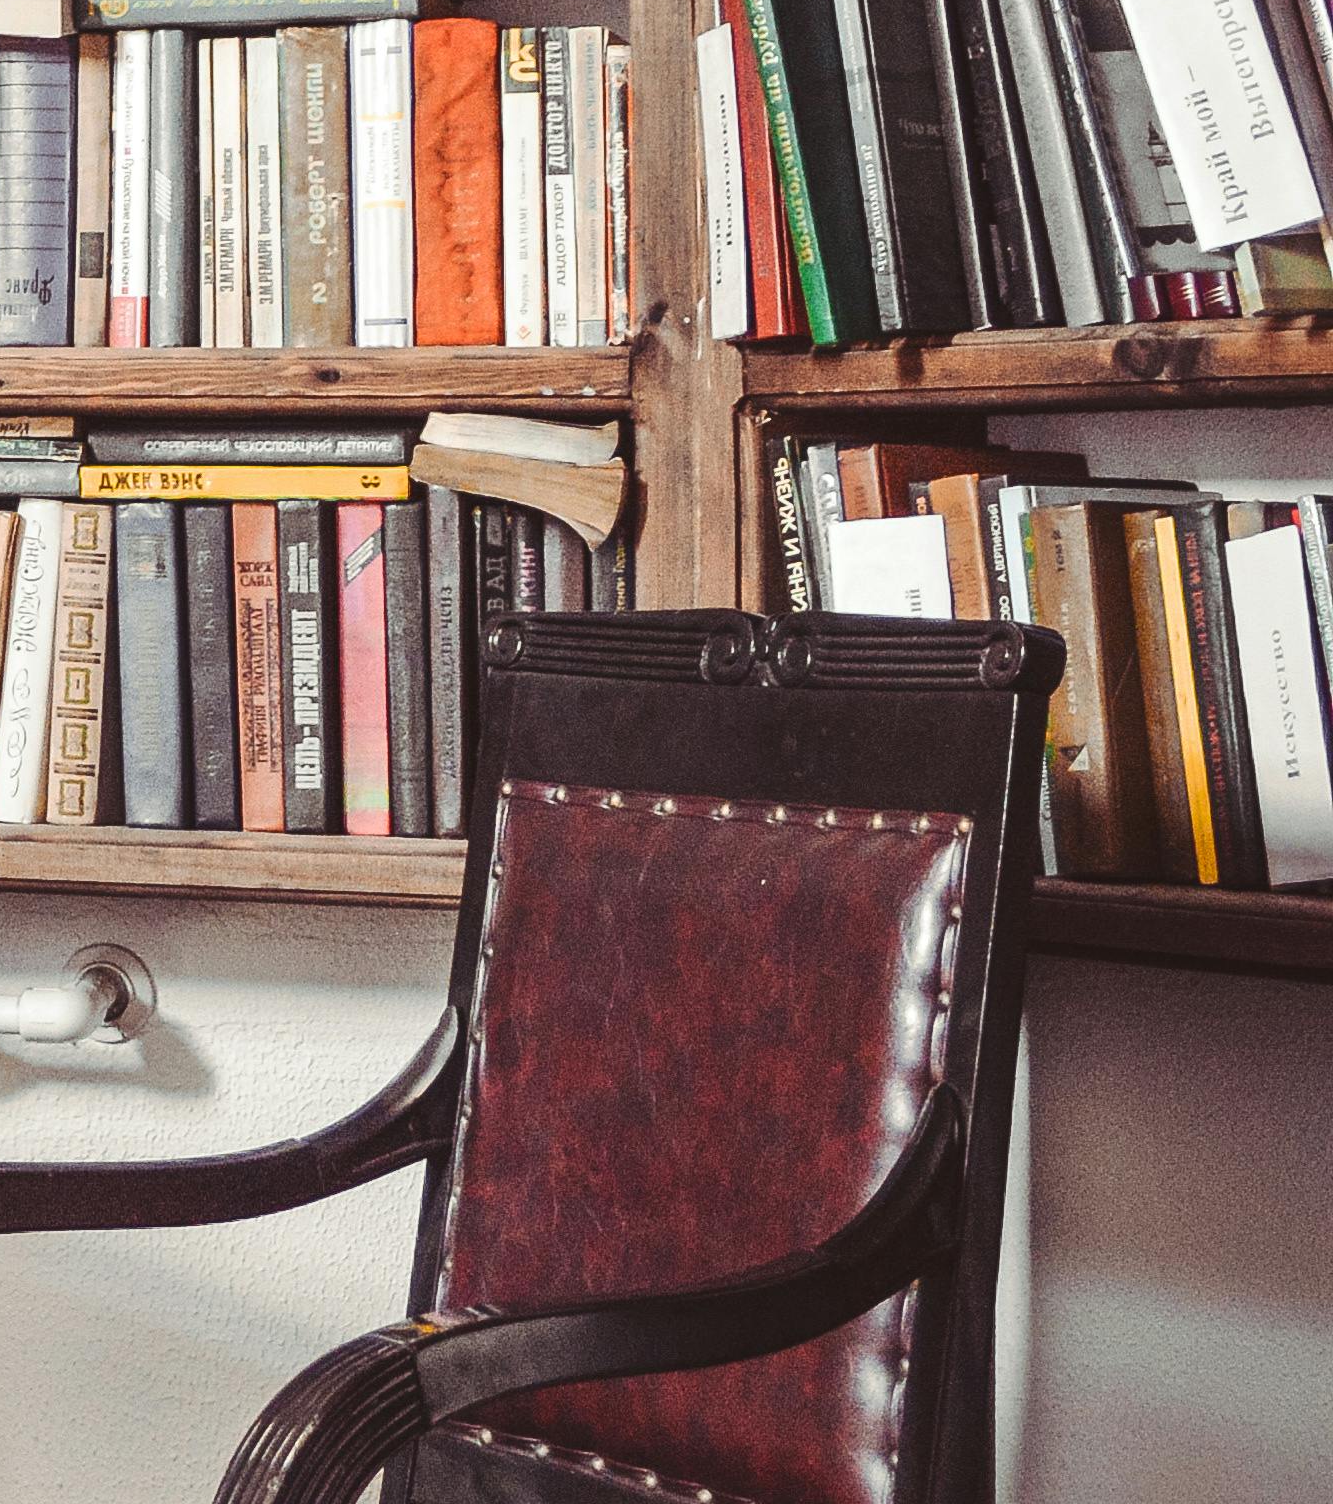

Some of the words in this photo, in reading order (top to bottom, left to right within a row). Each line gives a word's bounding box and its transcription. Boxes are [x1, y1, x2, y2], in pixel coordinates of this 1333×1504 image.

[544, 40, 564, 96] НИКТО
[767, 73, 784, 104] на
[546, 101, 567, 170] ДОКТОР
[1199, 91, 1227, 154] мой
[221, 187, 234, 222] Черный
[553, 182, 565, 231] ГАБОР
[1219, 163, 1249, 228] Край
[554, 234, 567, 287] АНДОР
[312, 281, 328, 303] 2
[233, 439, 333, 452] ЧЕХОСЛОВАЦКИЙ
[336, 441, 393, 454] ДЕТЕКТИВ
[99, 472, 153, 493] ДЖЕК
[160, 472, 204, 490] ВЭНС
[360, 474, 381, 489] 3
[774, 457, 797, 534] ЖИЗНЬ
[786, 538, 801, 556] И
[291, 609, 322, 789] ЦЕЛЬ-ПРЕЗИДЕНТ
[1270, 628, 1300, 780] Искусство
[253, 704, 268, 764] ГРАФИНЯ
